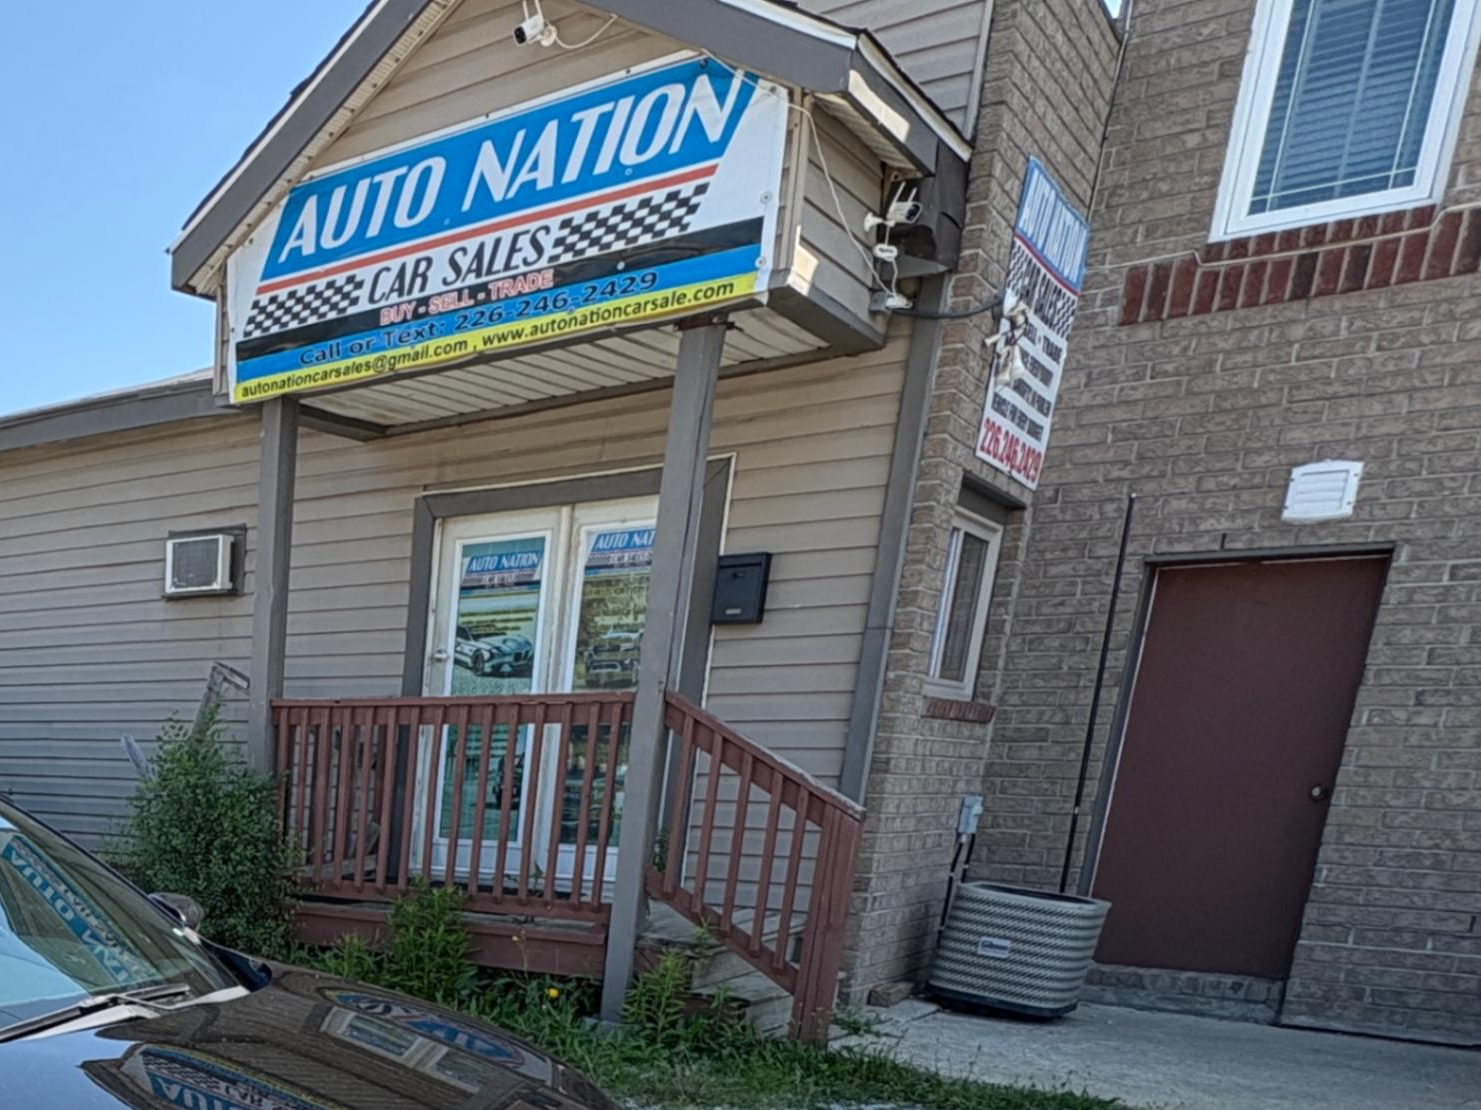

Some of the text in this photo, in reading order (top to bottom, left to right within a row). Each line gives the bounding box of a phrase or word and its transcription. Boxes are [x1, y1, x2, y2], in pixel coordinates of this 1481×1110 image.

[279, 68, 744, 264] AUTO NATION
[369, 225, 550, 304] CAR SALES
[380, 269, 554, 326] BUY SELL TRADE
[241, 280, 735, 398] autonationcarsales@gmail.com www.autonationcarsale.com
[300, 271, 658, 366] Call or Text: 226-246-2429
[469, 551, 538, 571] AUTO NATION
[594, 532, 629, 549] AUTO
